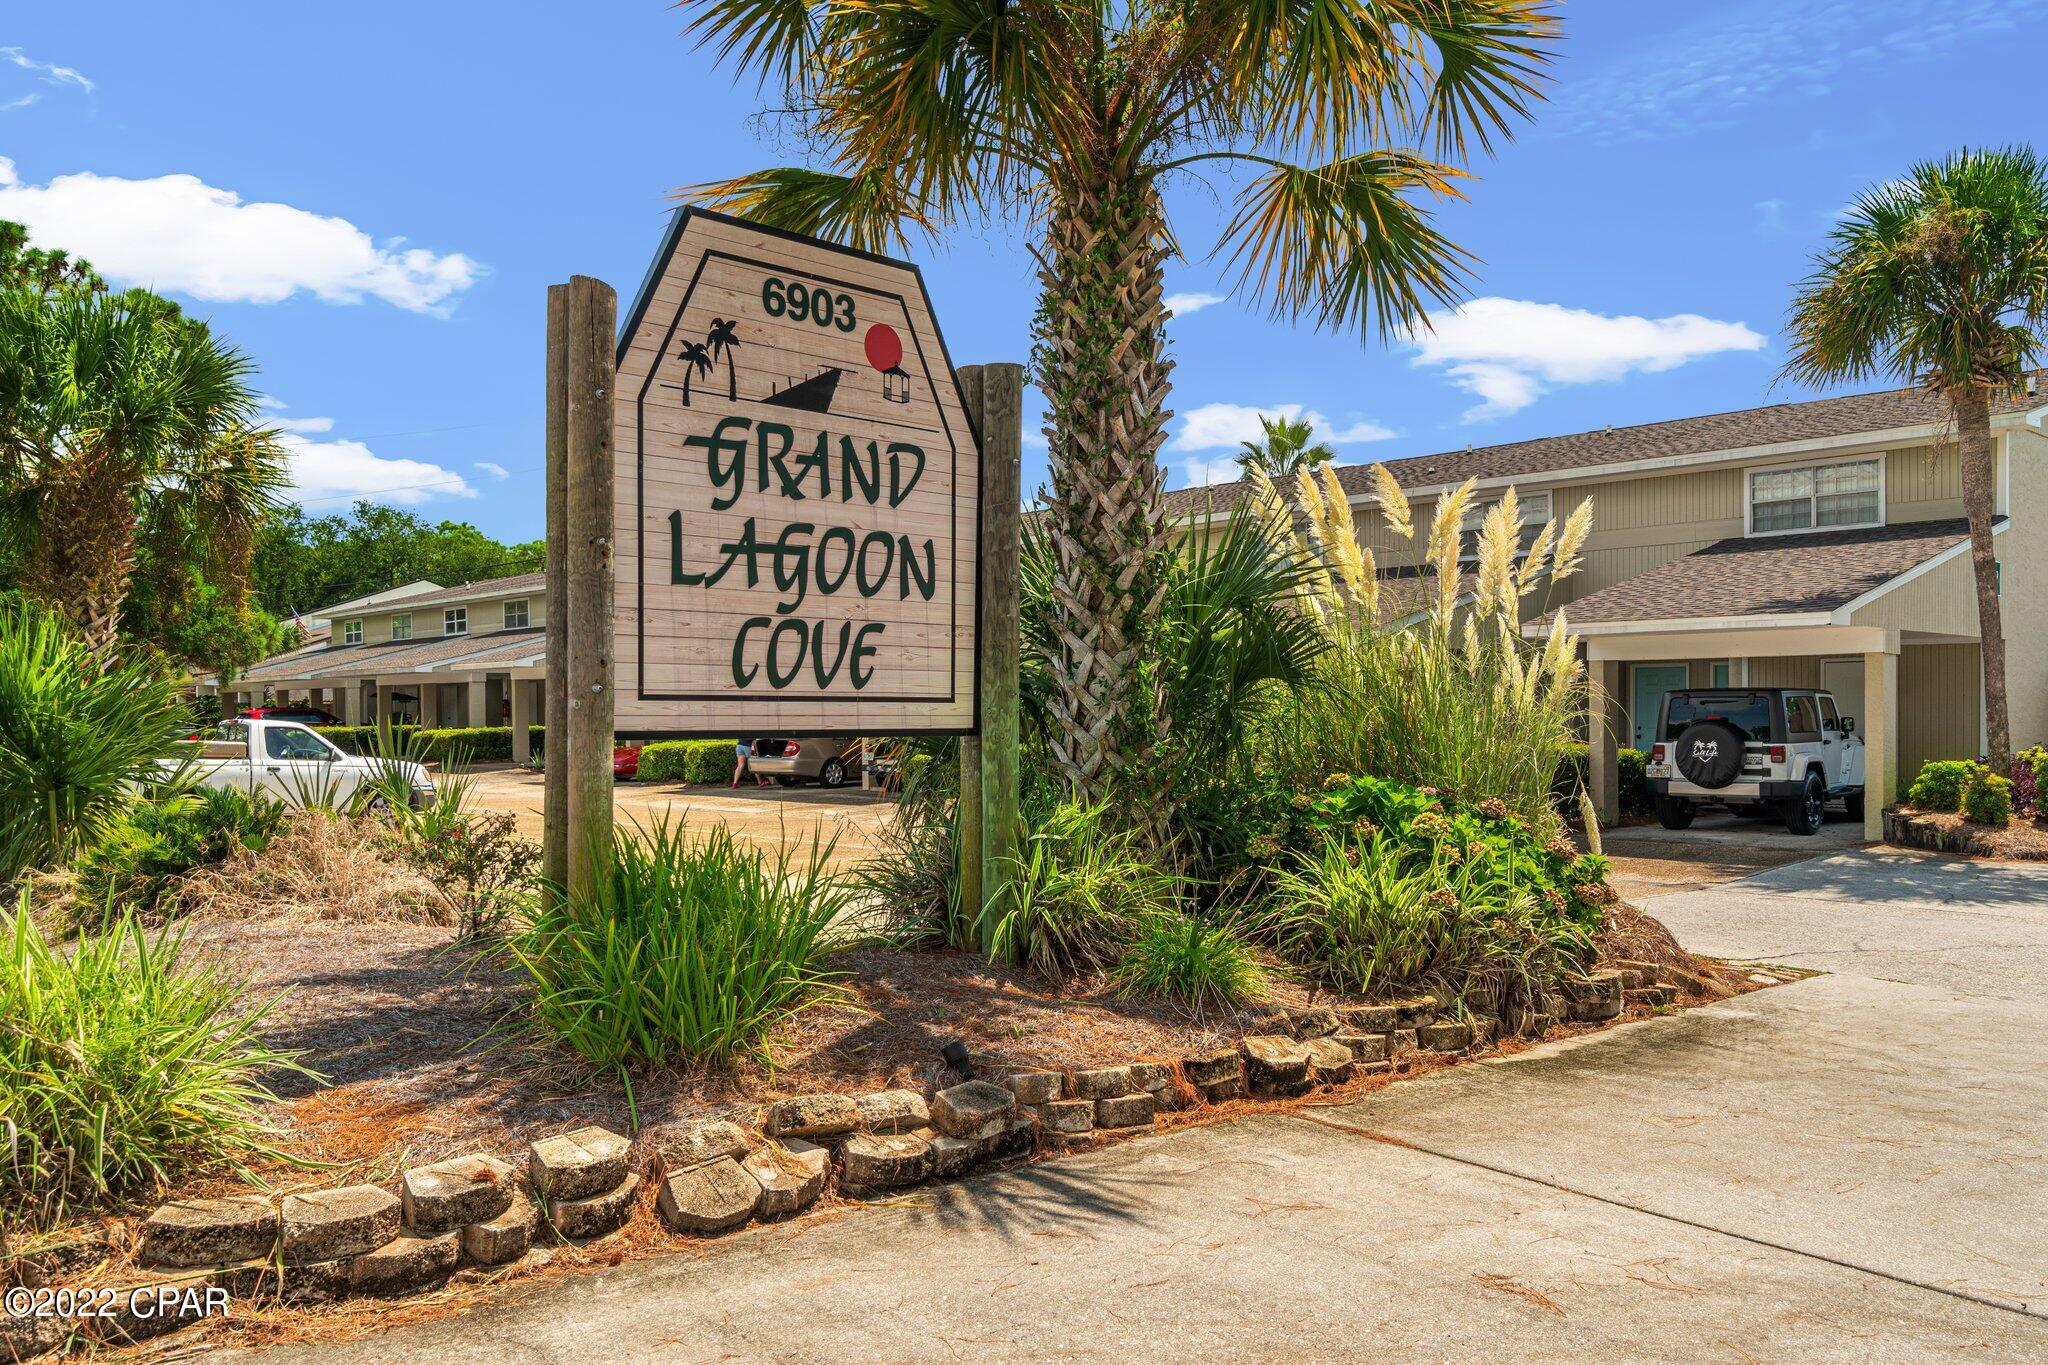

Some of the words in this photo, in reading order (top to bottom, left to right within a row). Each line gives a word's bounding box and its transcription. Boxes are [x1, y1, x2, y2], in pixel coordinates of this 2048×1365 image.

[763, 278, 857, 333] 6903
[685, 416, 925, 510] GRAND
[668, 510, 935, 614] LAGOON
[731, 617, 886, 690] COVE
